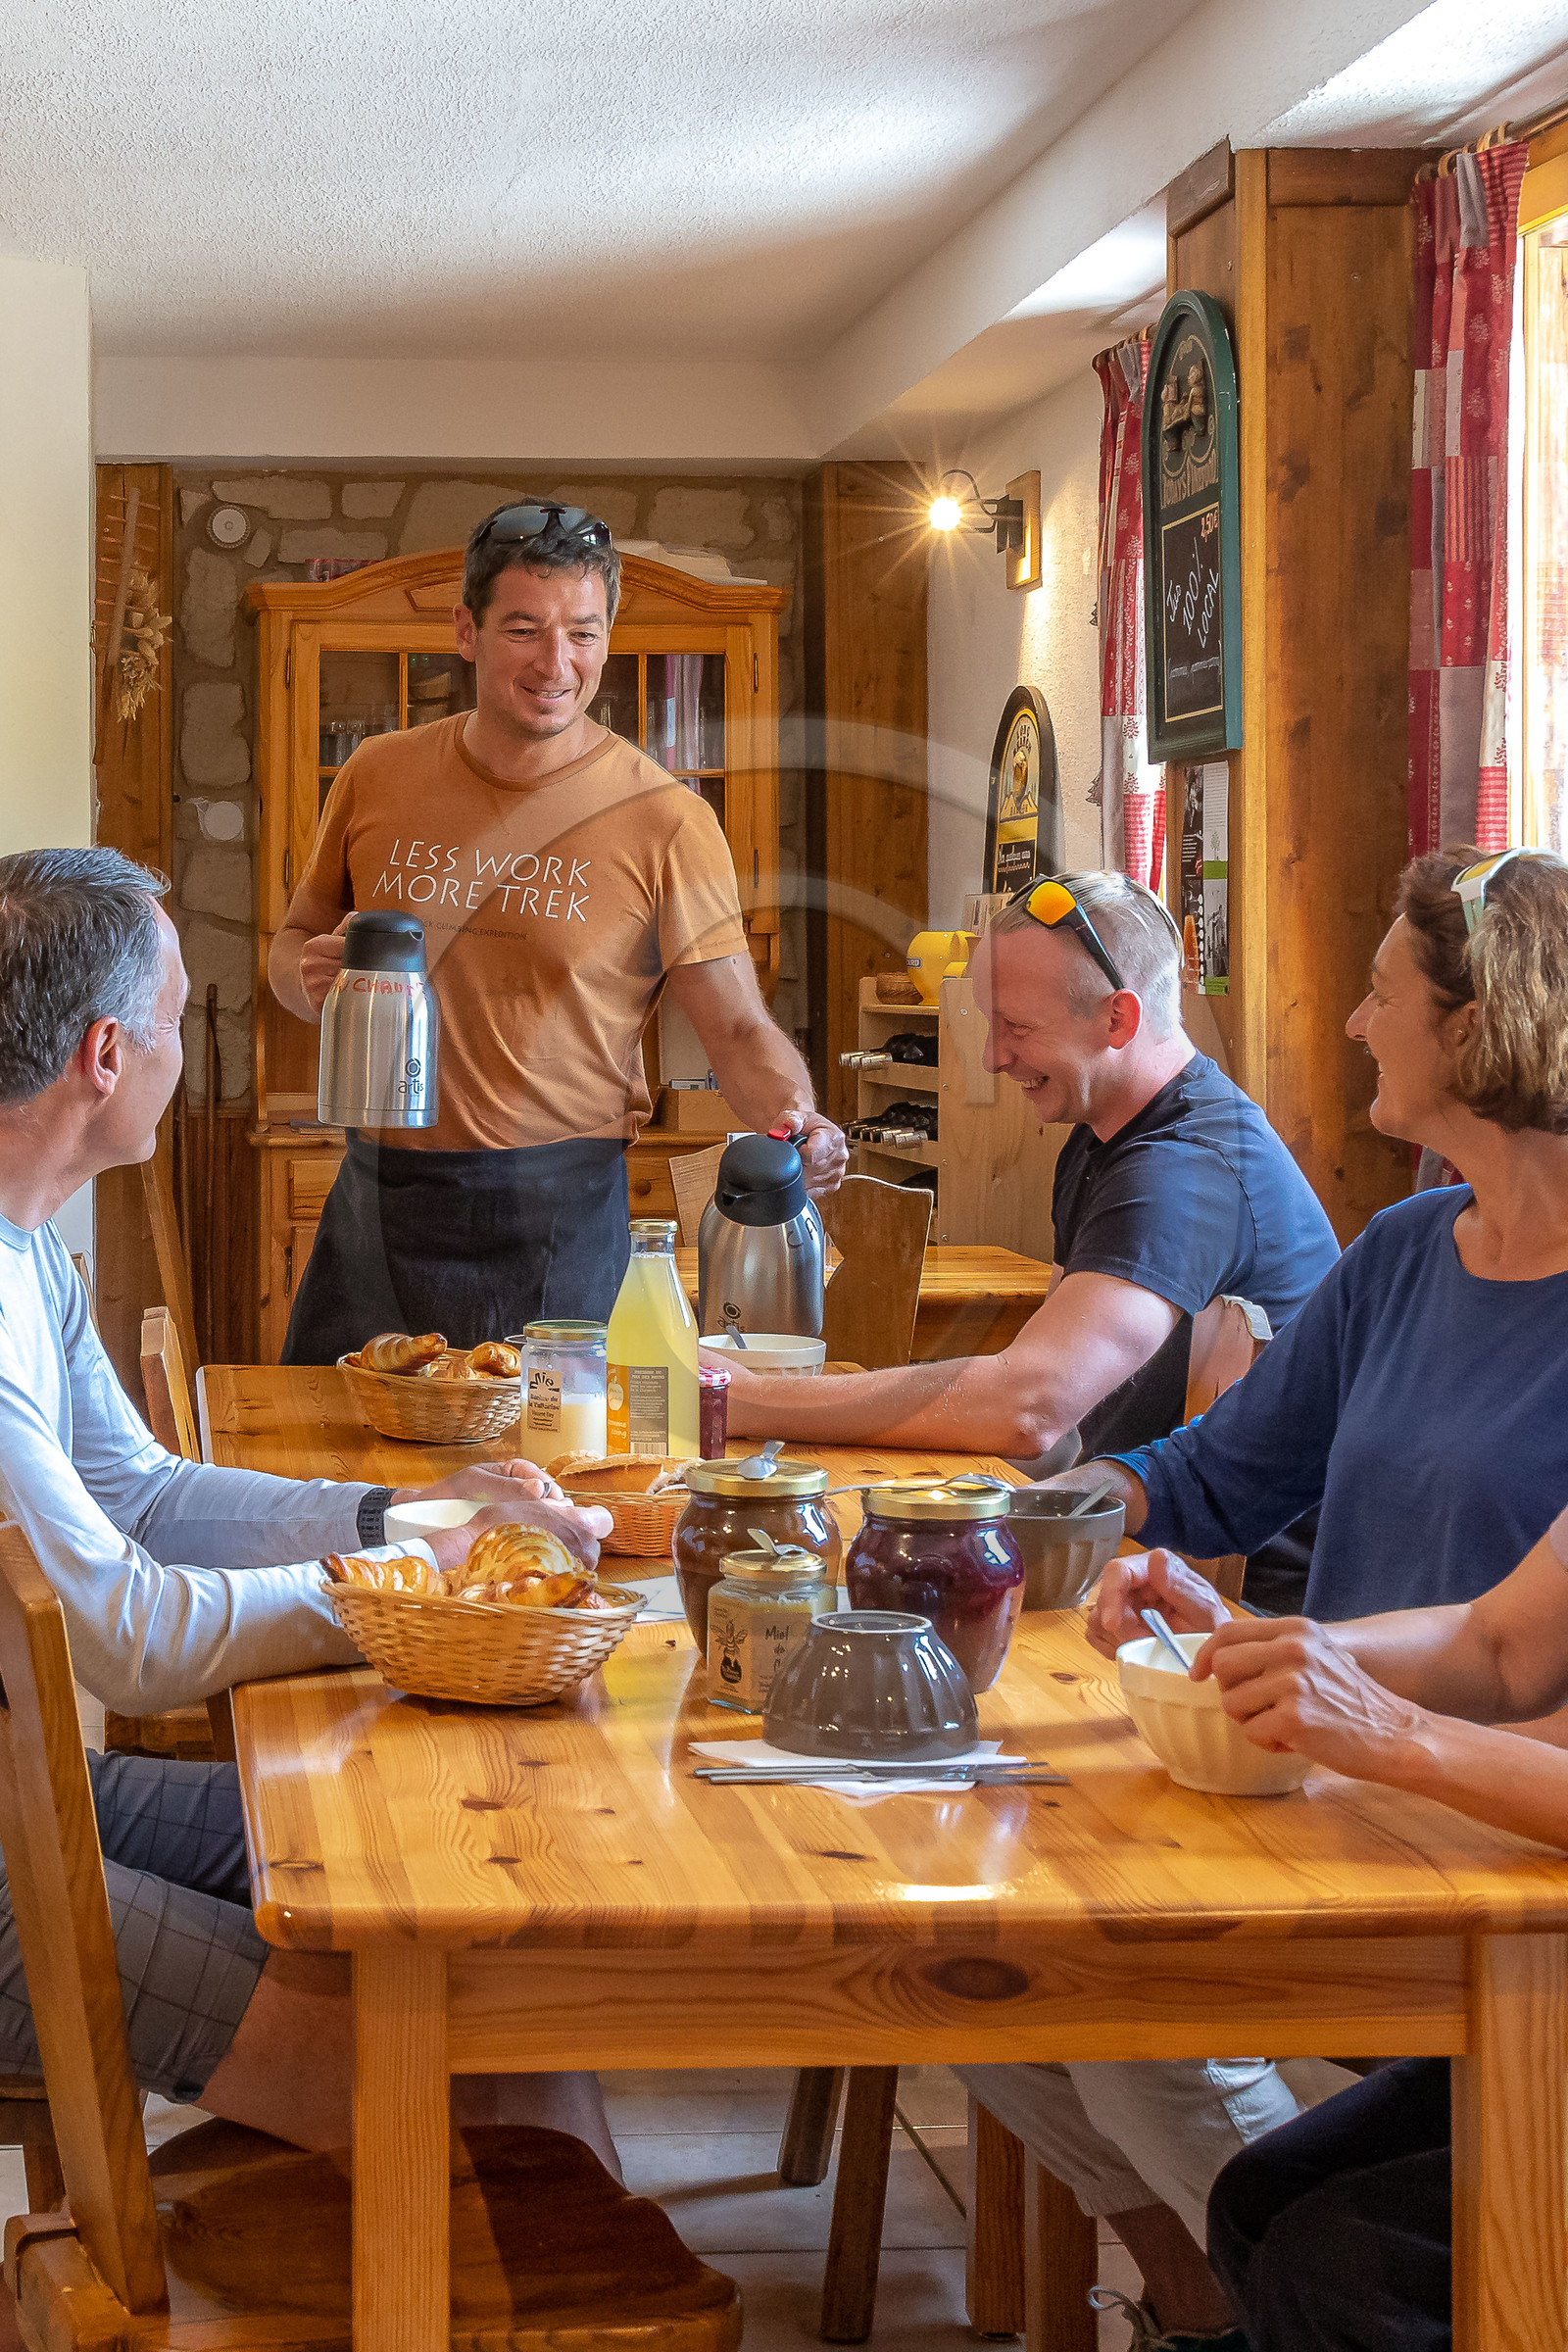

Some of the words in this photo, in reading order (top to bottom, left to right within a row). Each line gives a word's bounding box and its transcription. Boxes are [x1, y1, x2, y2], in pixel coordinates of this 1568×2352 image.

[1198, 568, 1219, 649] LOCAL
[389, 839, 460, 872] LESS
[475, 849, 591, 887] WORK
[372, 870, 484, 910] MORE
[497, 884, 590, 922] TREK
[398, 1078, 424, 1095] artis
[530, 1372, 560, 1392] Miel
[765, 1625, 789, 1641] Miel
